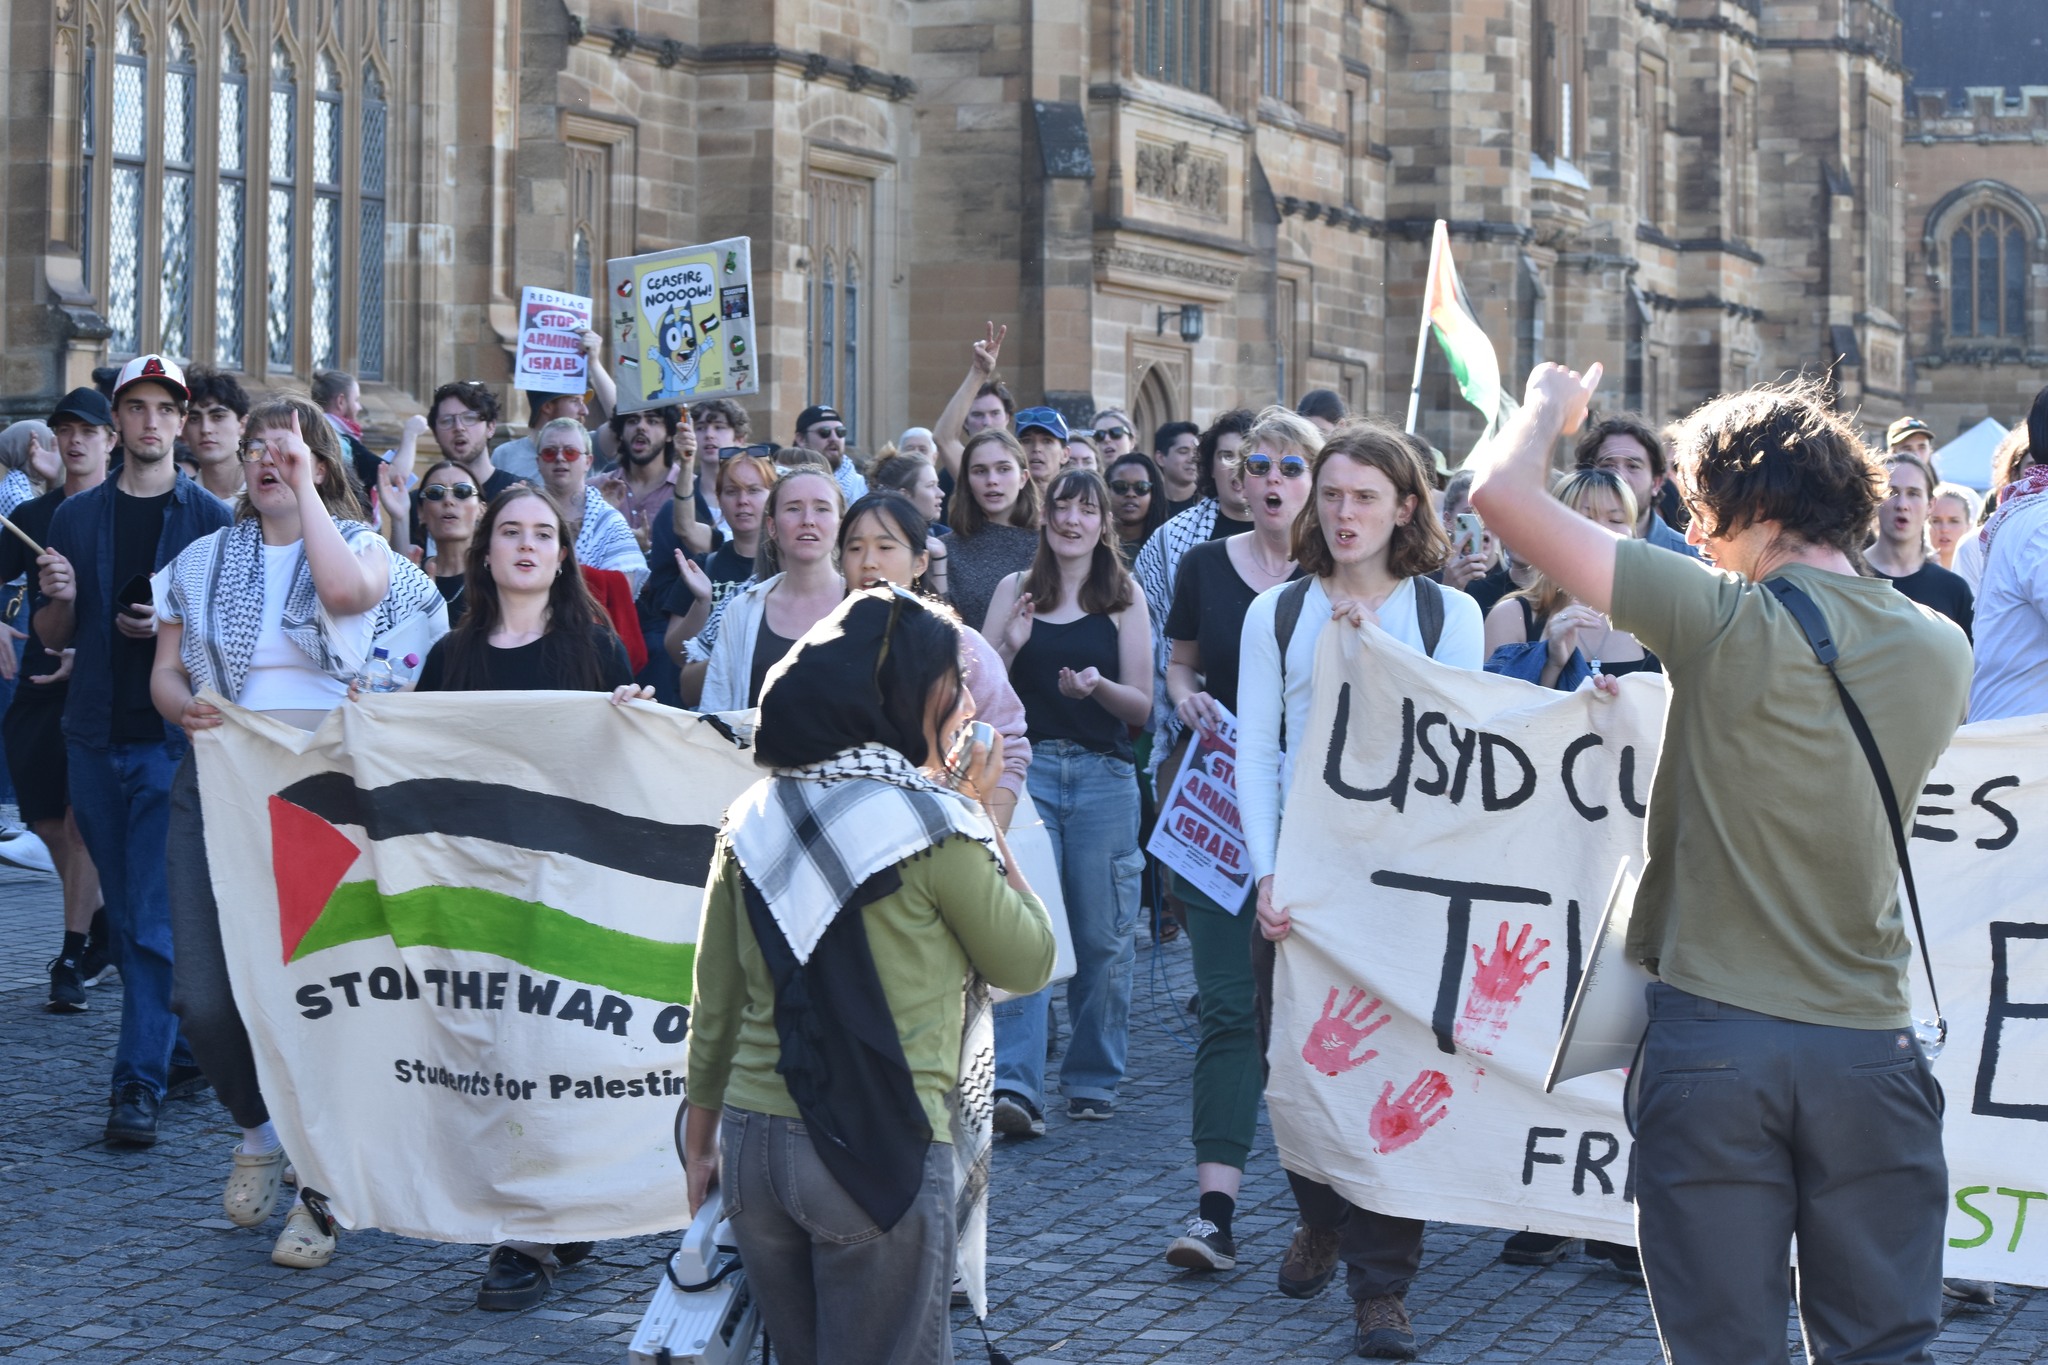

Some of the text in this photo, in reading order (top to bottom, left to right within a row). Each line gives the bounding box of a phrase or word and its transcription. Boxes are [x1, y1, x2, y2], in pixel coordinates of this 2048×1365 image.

[645, 284, 712, 307] NOOOOW!
[647, 270, 703, 290] CEASFIRE
[541, 314, 575, 328] STOP
[141, 357, 166, 376] A
[528, 356, 578, 371] ISRAEL
[1323, 682, 1537, 814] USYD
[1185, 775, 1244, 835] ARMIN
[1175, 813, 1240, 870] ISRAEL
[424, 969, 509, 1011] THE
[518, 974, 634, 1037] WAR
[394, 1058, 491, 1097] Students
[494, 1072, 537, 1101] for
[1522, 1126, 1637, 1205] FR
